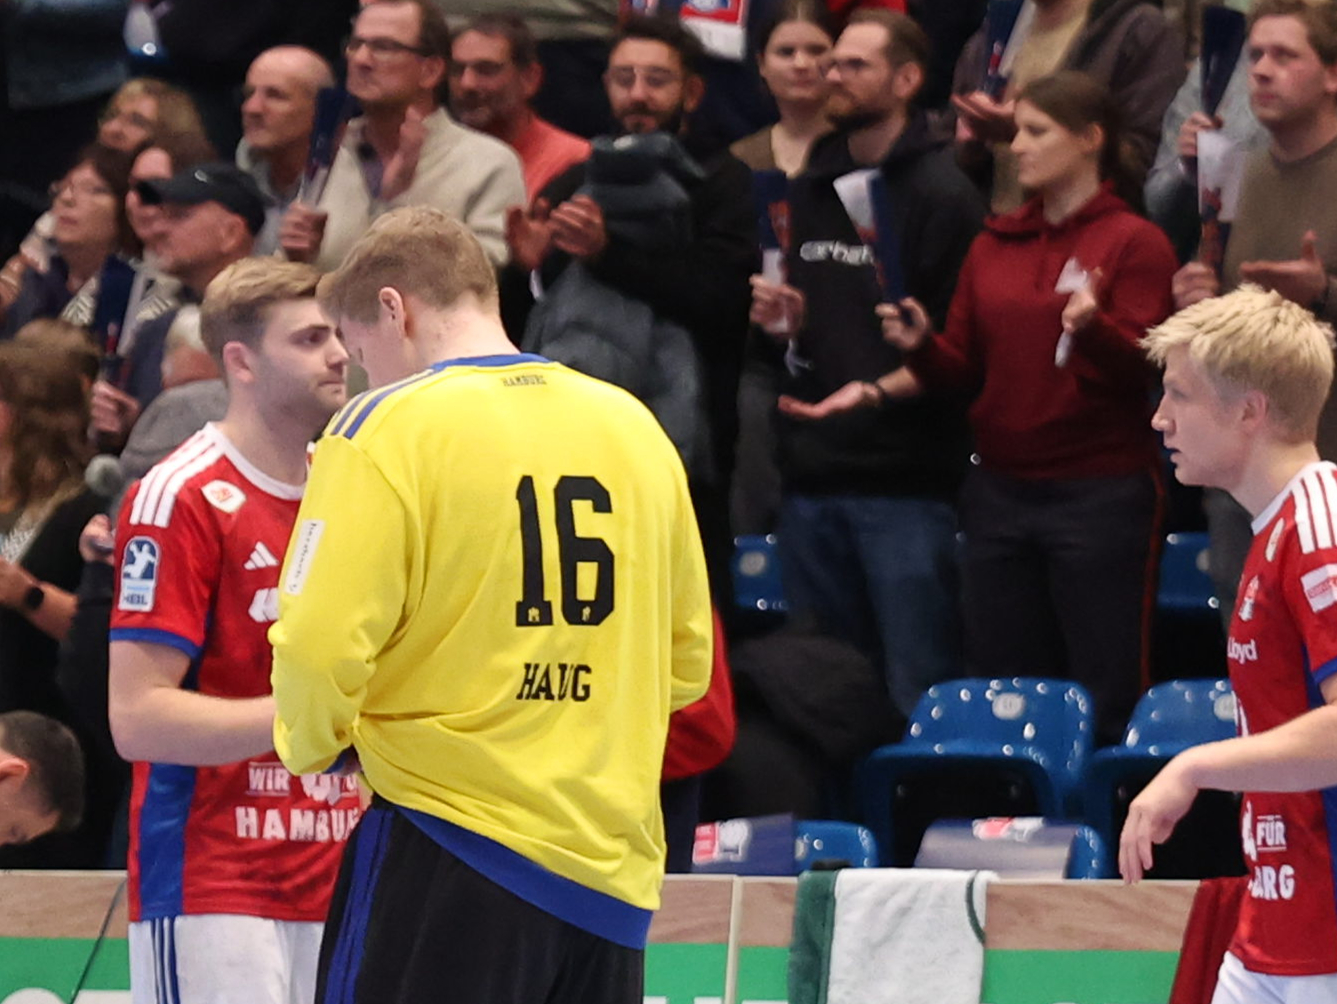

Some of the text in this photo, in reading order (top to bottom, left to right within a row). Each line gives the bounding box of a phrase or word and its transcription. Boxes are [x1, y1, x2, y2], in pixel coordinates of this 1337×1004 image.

[516, 475, 615, 627] 16
[516, 661, 592, 701] HAUG
[248, 768, 290, 791] WIR
[1257, 815, 1286, 846] FÜR
